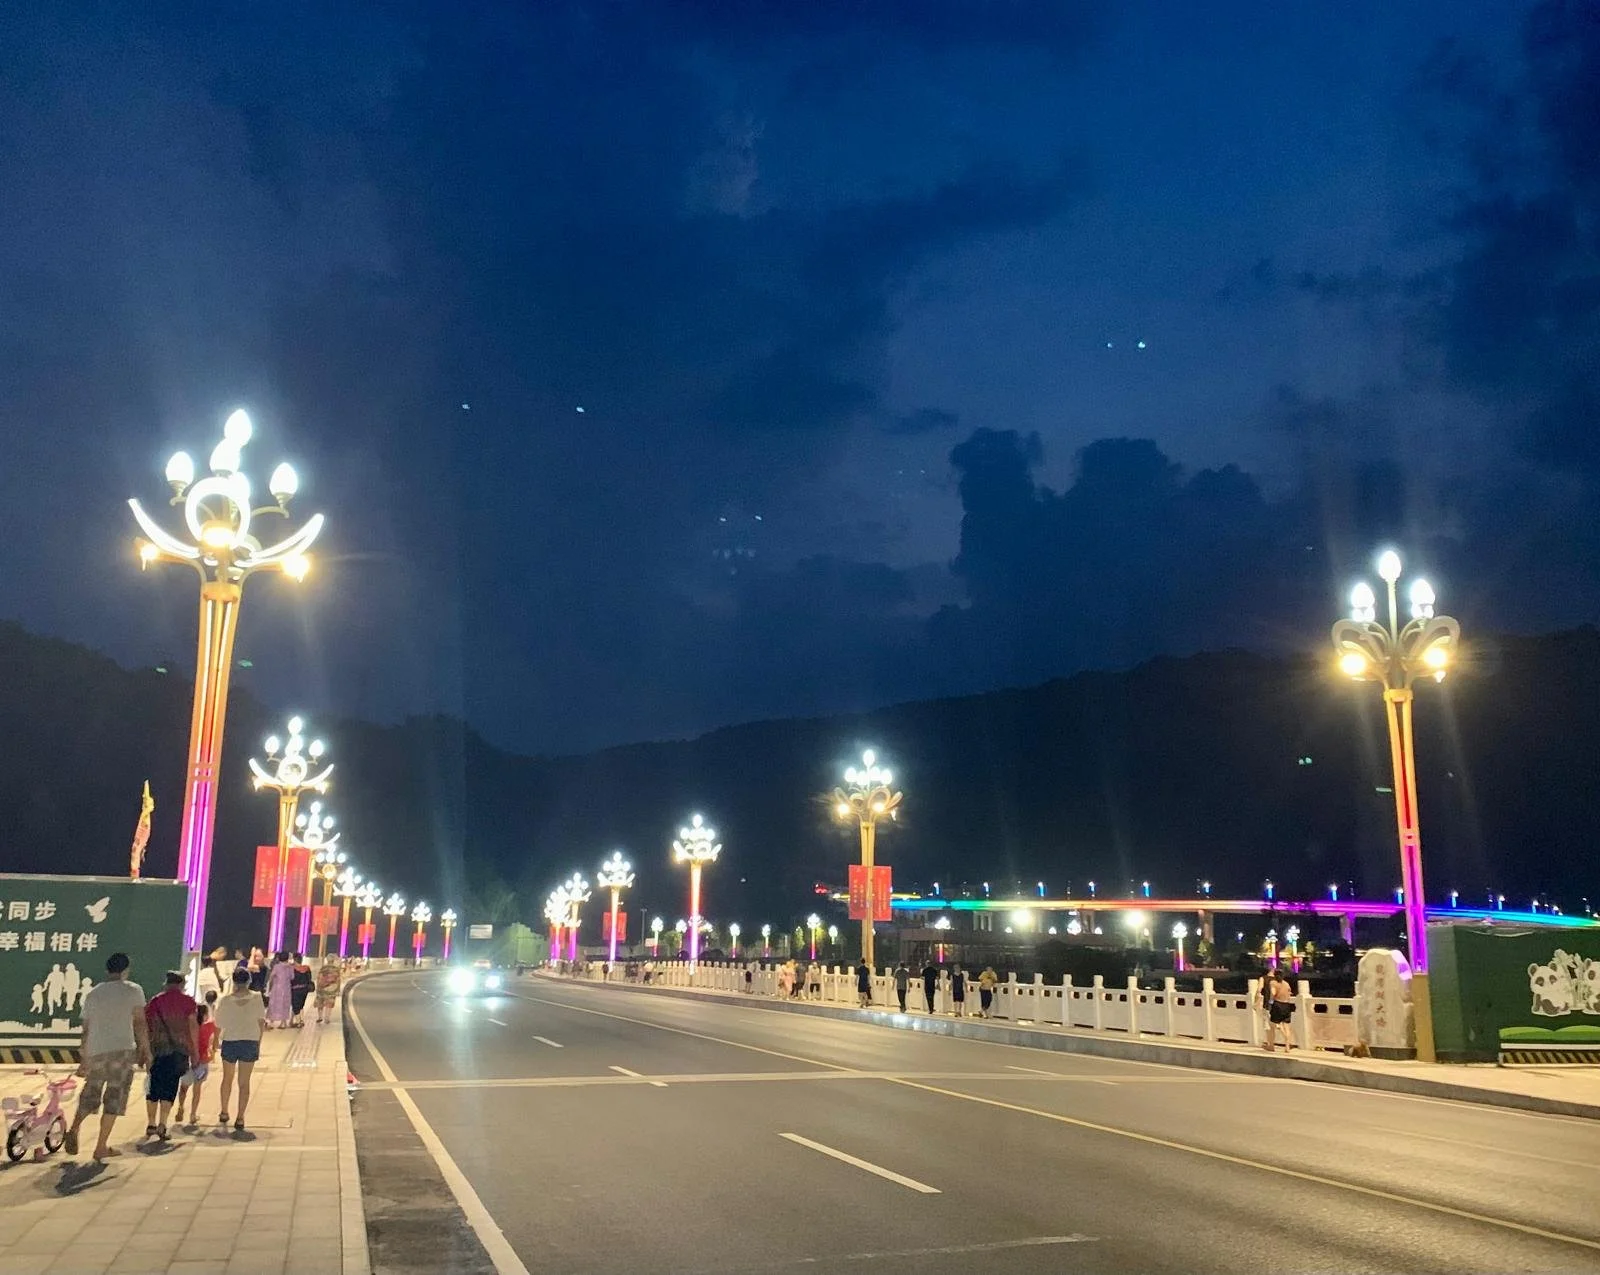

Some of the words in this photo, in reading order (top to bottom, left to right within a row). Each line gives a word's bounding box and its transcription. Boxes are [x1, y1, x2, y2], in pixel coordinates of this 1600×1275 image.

[0, 900, 57, 921] 同步
[0, 931, 98, 952] 幸福相伴
